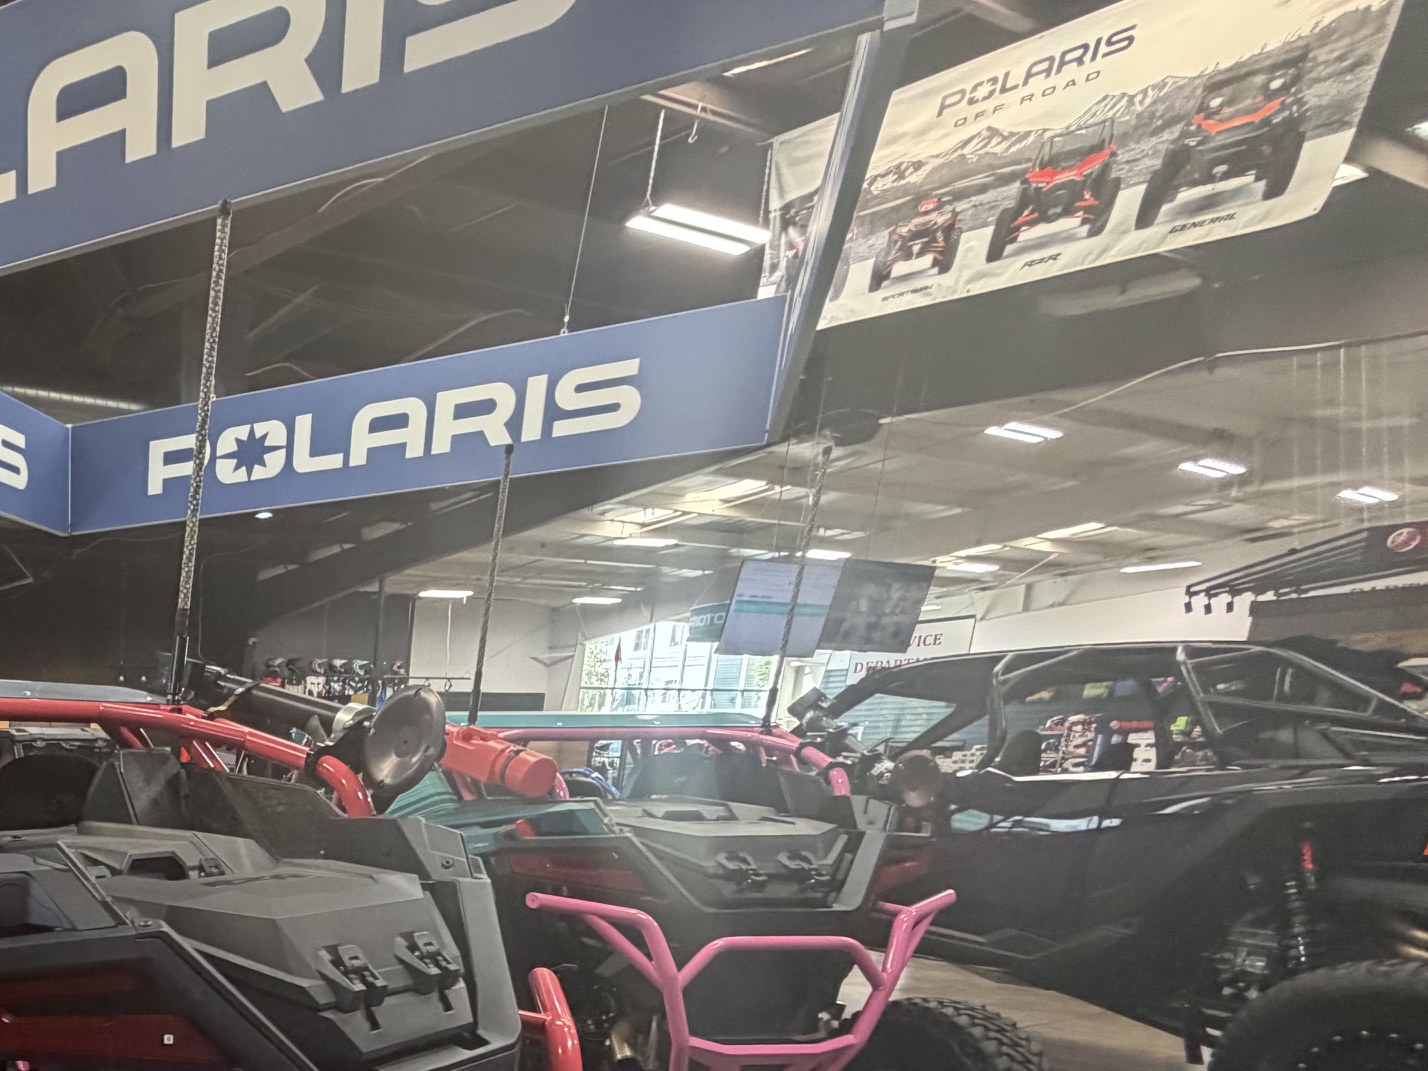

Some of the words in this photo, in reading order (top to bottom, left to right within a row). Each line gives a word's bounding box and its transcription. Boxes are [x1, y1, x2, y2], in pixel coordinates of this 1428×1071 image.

[936, 23, 1138, 119] POLARIS
[953, 103, 1005, 128] OFF
[1019, 70, 1101, 106] ROAD
[1168, 211, 1238, 234] GENERAL
[1020, 252, 1062, 270] RZR
[147, 358, 642, 496] POLARIS
[909, 633, 943, 648] VICE
